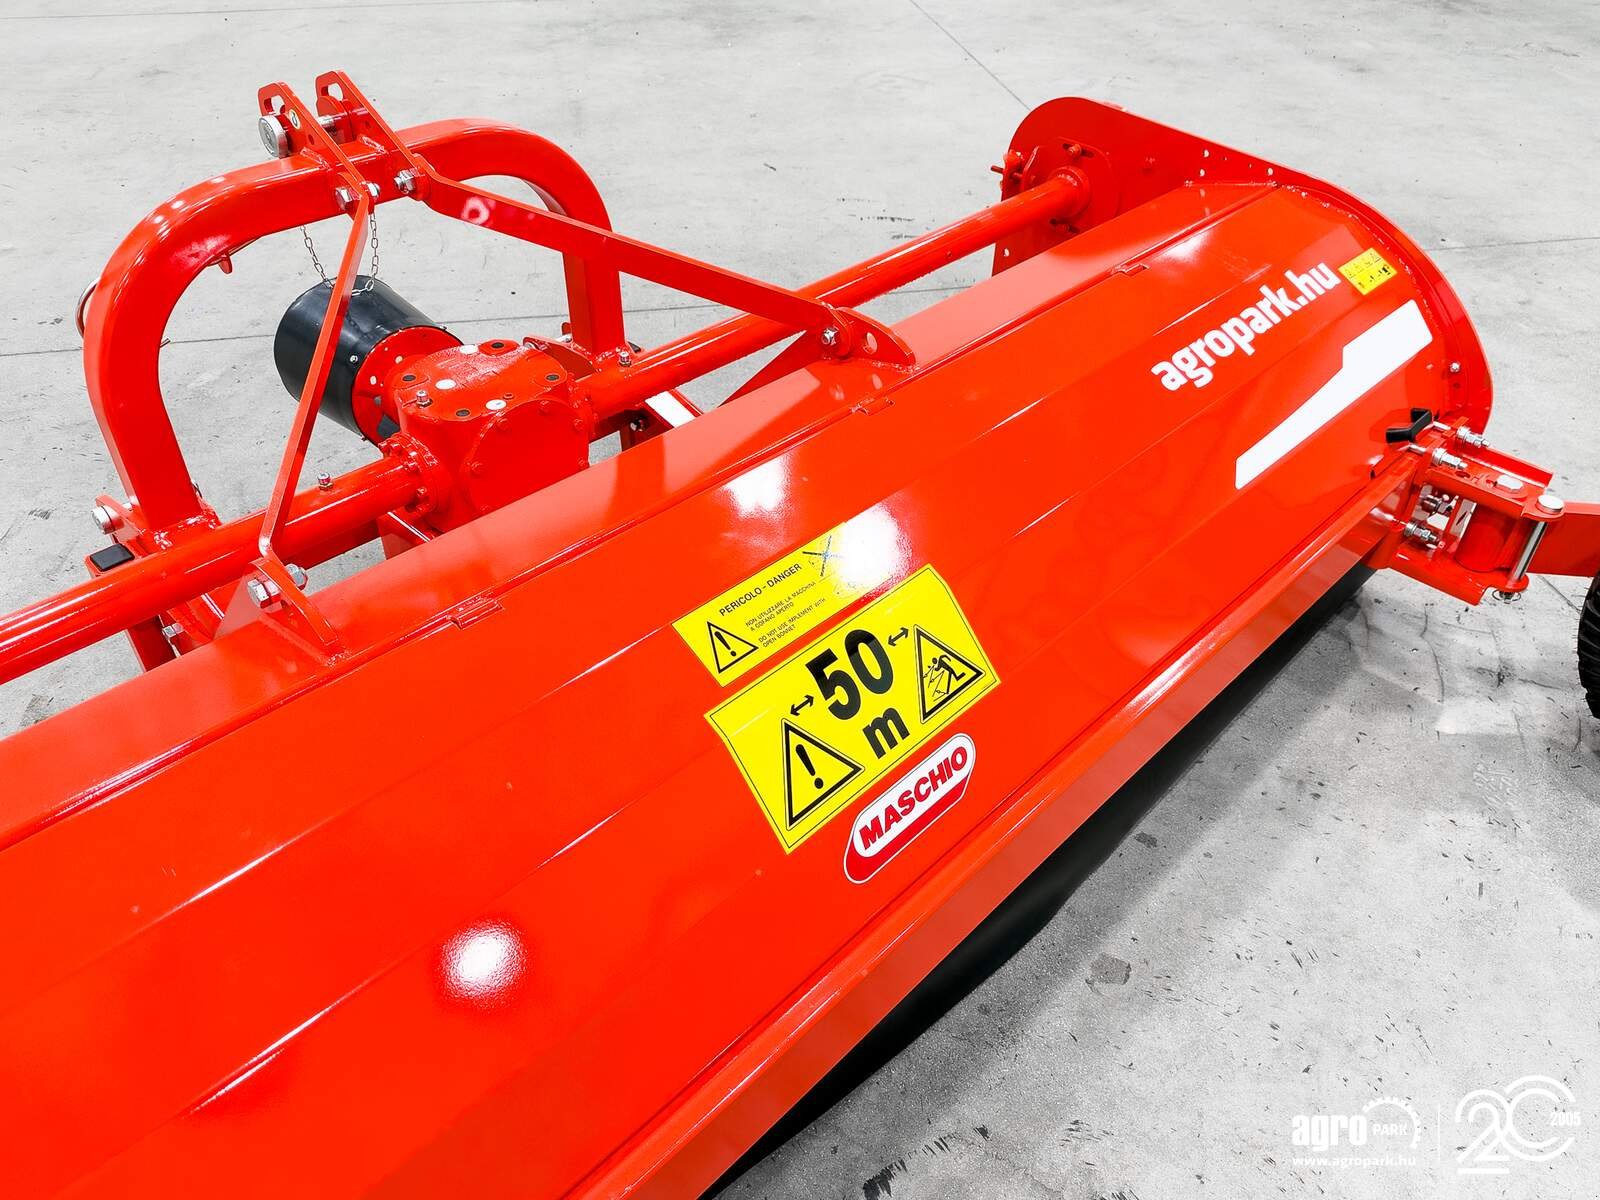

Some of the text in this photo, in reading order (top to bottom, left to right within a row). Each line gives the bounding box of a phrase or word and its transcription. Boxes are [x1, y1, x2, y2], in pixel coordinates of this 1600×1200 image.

[1150, 262, 1342, 391] agropark.hu
[719, 587, 762, 616] PERICOLO
[766, 563, 802, 588] DANGER
[767, 628, 777, 637] NOT
[777, 621, 788, 631] USE
[805, 628, 894, 720] 50
[862, 707, 910, 760] m
[858, 746, 968, 850] MASCHIO
